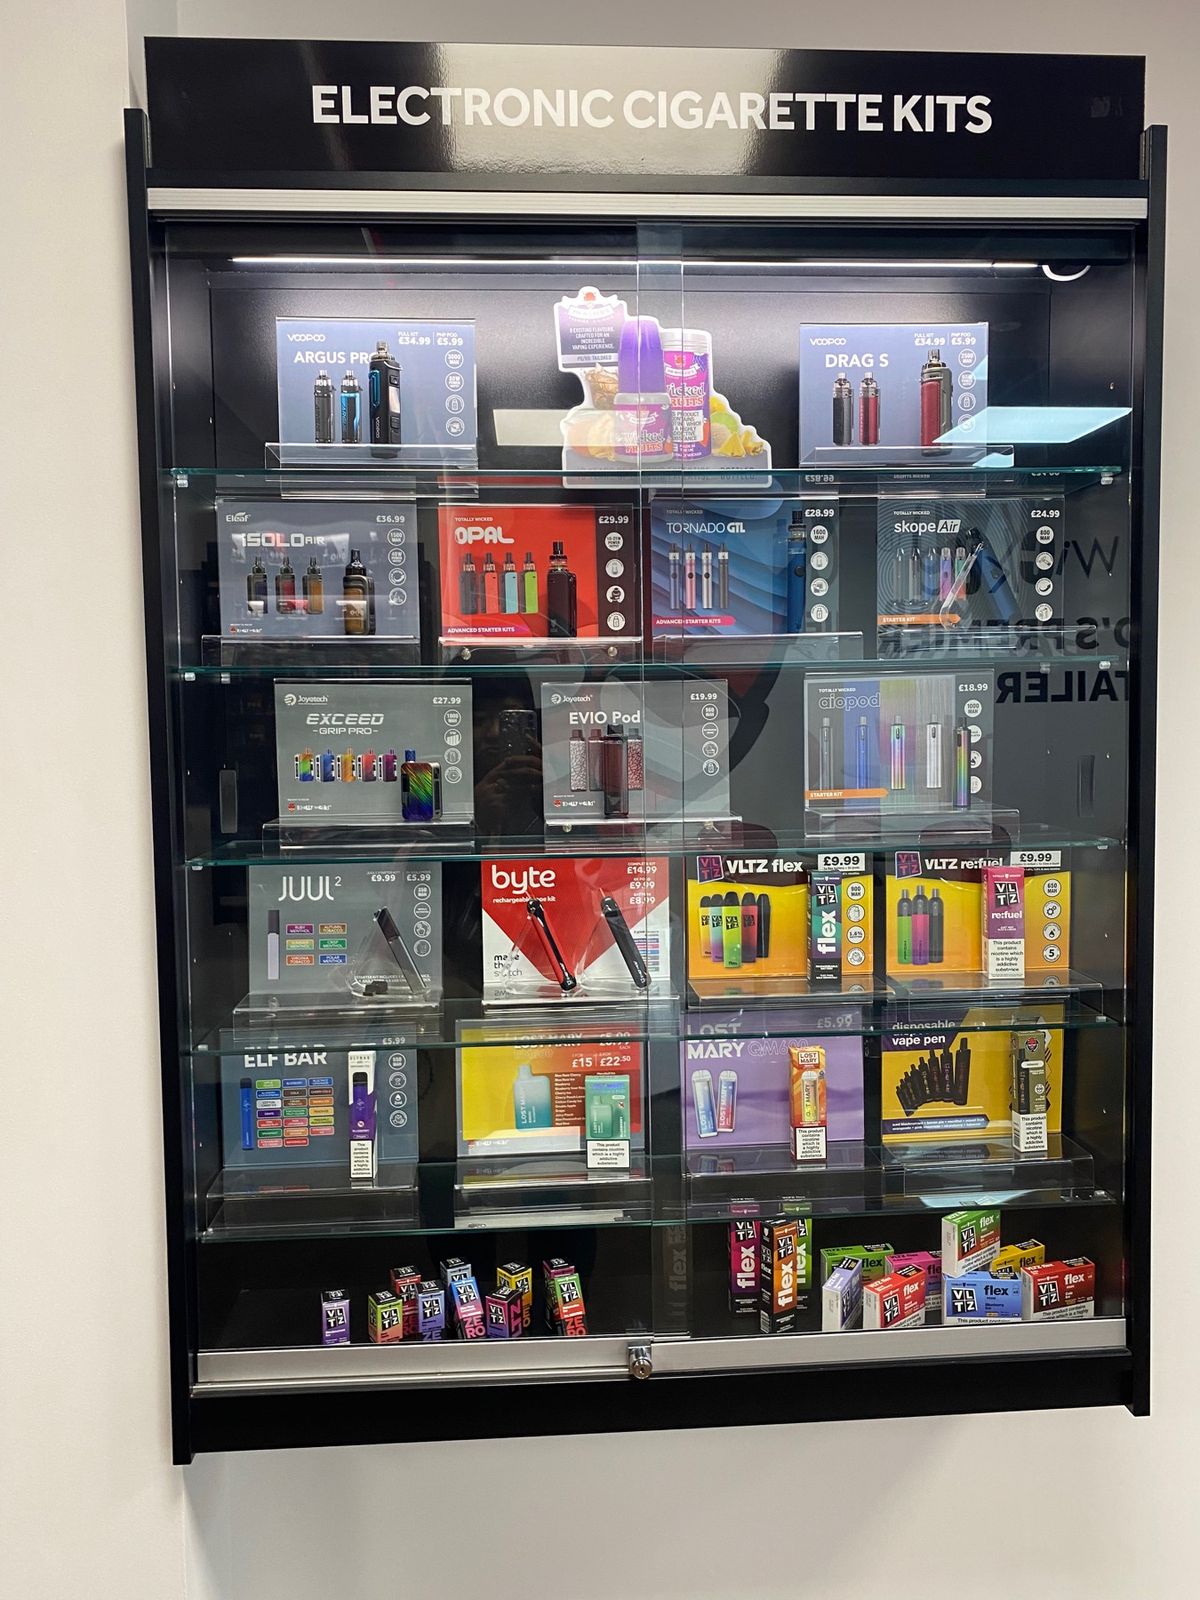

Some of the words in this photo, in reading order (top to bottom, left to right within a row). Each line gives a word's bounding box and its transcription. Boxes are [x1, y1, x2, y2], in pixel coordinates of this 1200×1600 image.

[312, 85, 614, 128] ELECTRONIC
[622, 90, 884, 132] CIGARETTE
[893, 94, 993, 135] KITS
[287, 334, 326, 342] VOOPOO
[398, 337, 431, 345] £34.99
[437, 338, 464, 346] £5.99
[914, 338, 946, 346] £34.99
[952, 337, 976, 346] £5.99
[294, 351, 346, 364] ARGUS
[350, 352, 376, 364] PR
[826, 354, 874, 368] DRAG
[879, 354, 888, 368] S
[226, 512, 250, 522] Eleaf
[376, 515, 406, 523] £36.99
[805, 509, 834, 518] £28.99
[1031, 510, 1060, 518] £24.99
[598, 516, 629, 524] £29.99
[667, 522, 726, 534] TORNADO
[894, 520, 936, 536] skope
[939, 520, 960, 532] Air
[455, 526, 515, 544] OPAL
[959, 684, 988, 692] £18.99
[433, 696, 462, 704] £27.99
[819, 694, 880, 710] aiopod
[306, 714, 384, 725] EXCEED
[570, 712, 608, 724] EVIO
[612, 710, 641, 724] Pod
[823, 856, 860, 867] £9.99
[1020, 853, 1052, 862] £9.99
[726, 859, 769, 874] VLTZ
[772, 858, 804, 873] flex
[925, 858, 958, 870] VLTZ
[961, 858, 1003, 870] re:fuel
[492, 864, 556, 894] byte
[992, 910, 1022, 919] re:fuel
[817, 910, 836, 954] flex
[1048, 949, 1054, 958] 5
[818, 1015, 852, 1028] £5.99
[892, 1034, 920, 1048] vape
[924, 1034, 946, 1046] pen
[688, 1042, 746, 1060] MARY
[572, 1058, 592, 1068] £15
[980, 1215, 994, 1228] flex
[736, 1245, 755, 1288] flex
[862, 1258, 882, 1268] flex
[1020, 1256, 1036, 1267] flex
[928, 1264, 942, 1274] fle
[778, 1260, 794, 1306] flex
[1064, 1274, 1085, 1285] flex
[902, 1282, 920, 1296] flex
[984, 1284, 1009, 1296] flex
